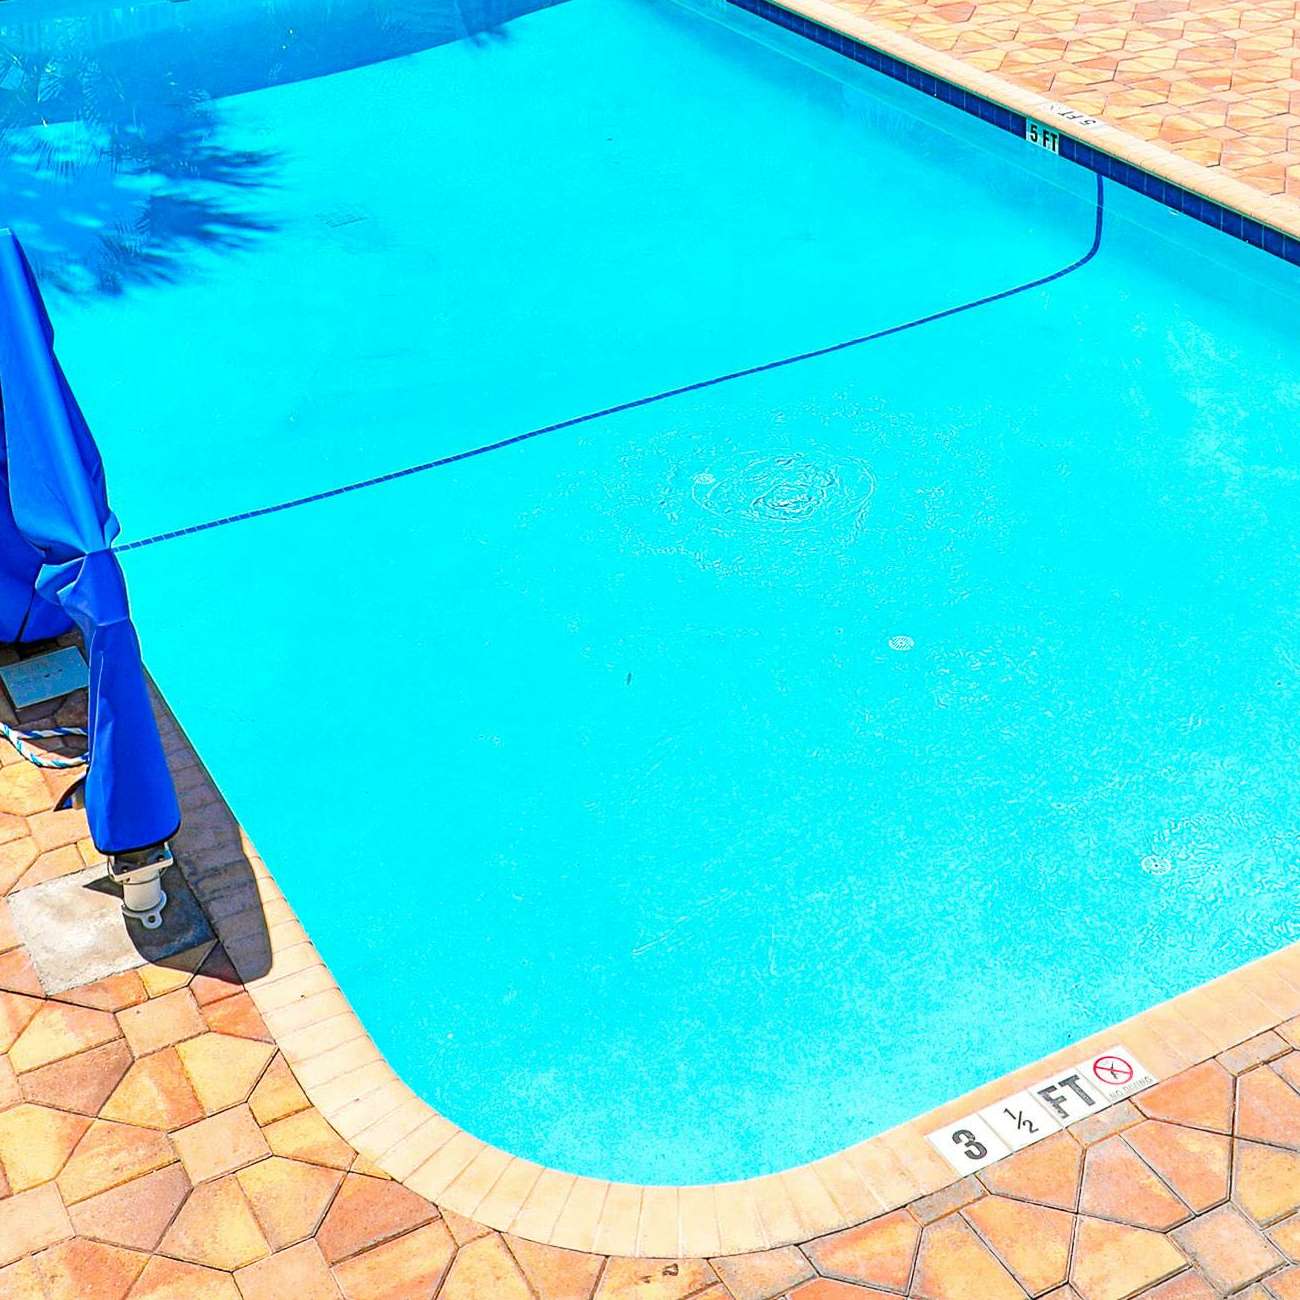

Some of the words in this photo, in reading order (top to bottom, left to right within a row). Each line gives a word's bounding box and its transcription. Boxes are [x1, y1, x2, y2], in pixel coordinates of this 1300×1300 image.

[1029, 124, 1038, 143] 5
[1042, 129, 1058, 152] FT
[951, 1128, 988, 1160] 3
[1037, 1073, 1096, 1120] FT
